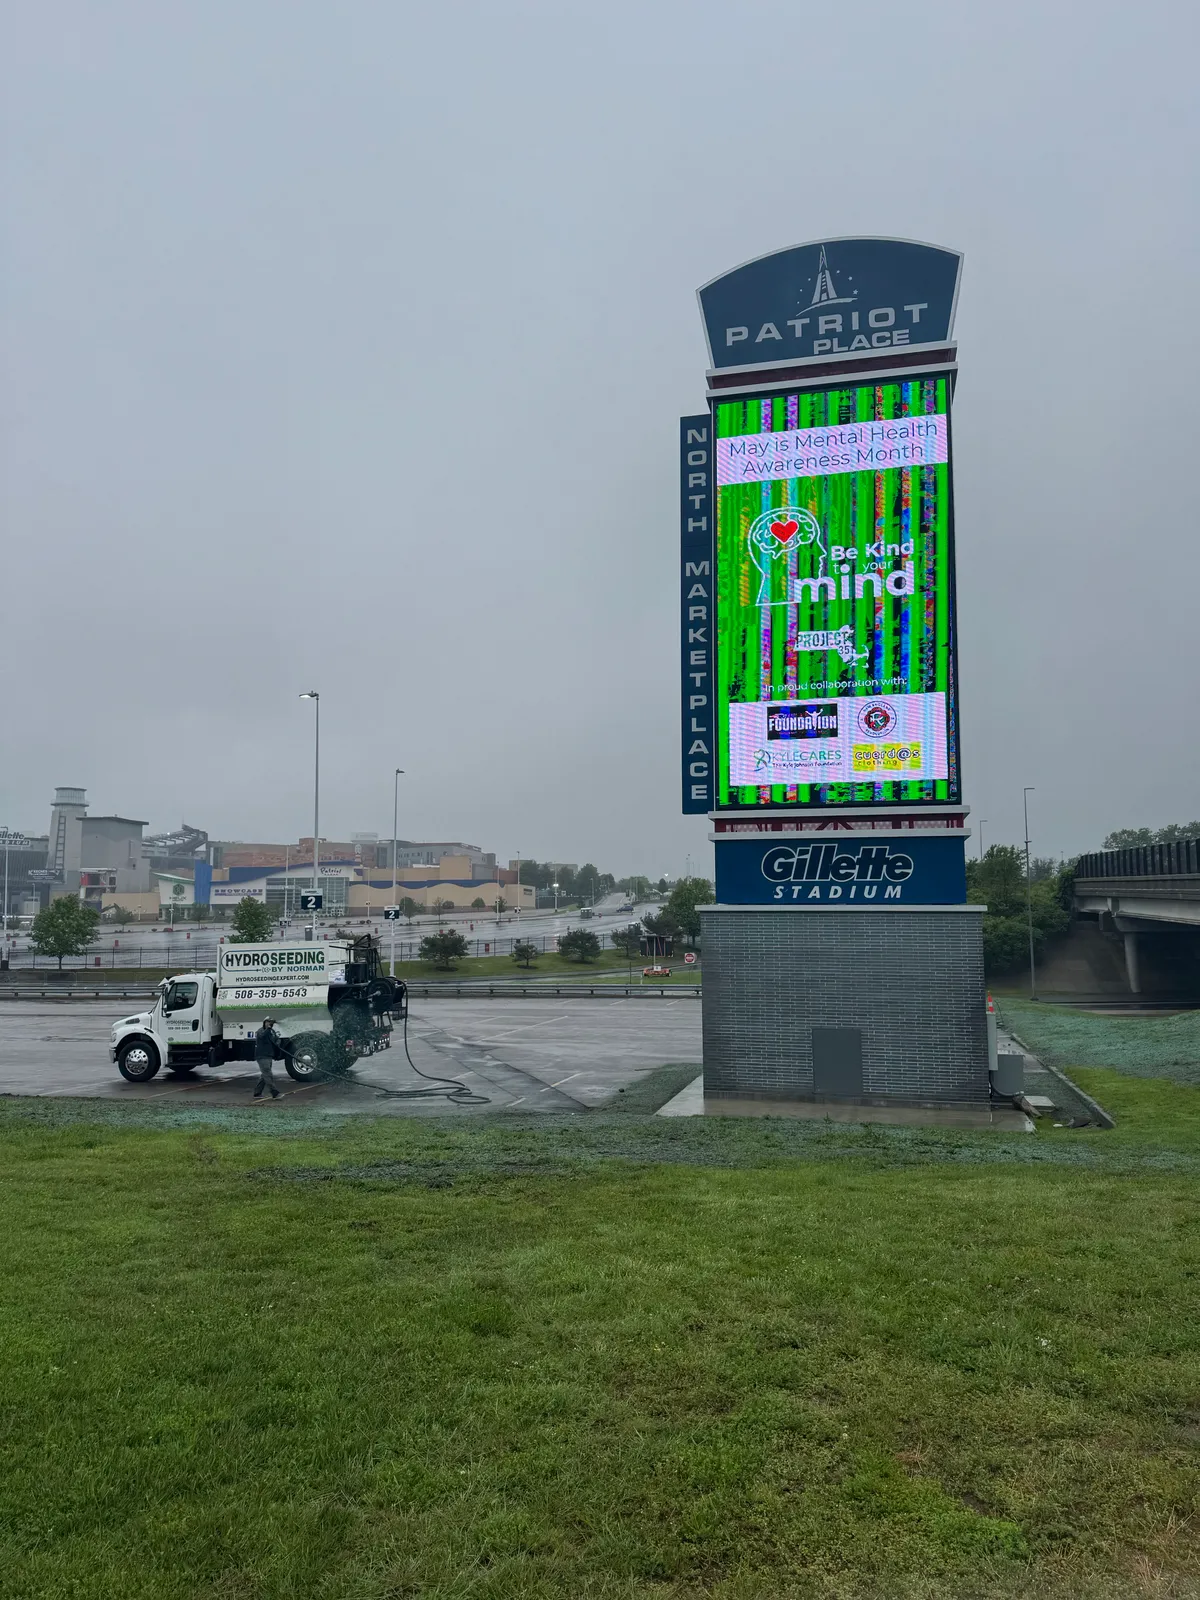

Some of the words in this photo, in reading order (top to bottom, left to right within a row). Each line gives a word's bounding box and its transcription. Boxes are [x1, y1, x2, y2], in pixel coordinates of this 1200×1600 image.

[726, 303, 928, 346] PATRIOT
[813, 329, 910, 355] PLACE
[729, 441, 769, 458] May
[775, 437, 789, 452] is
[795, 427, 863, 451] Mental
[870, 421, 938, 442] Health
[743, 453, 850, 476] Awareness
[857, 443, 923, 464] Month
[687, 428, 708, 533] NORTH
[831, 545, 858, 561] Be
[865, 538, 914, 558] Kind
[862, 559, 893, 573] your
[793, 560, 915, 603] mind
[797, 631, 849, 648] PROJECT
[685, 561, 710, 800] MARKETPLACE
[777, 682, 808, 693] proud
[810, 678, 879, 690] collaboration
[768, 712, 837, 732] FOUNDATION
[772, 750, 842, 762] KYLECARES
[855, 747, 920, 761] cuerd@s
[0, 830, 25, 840] illette
[761, 844, 914, 883] Gillette
[773, 885, 902, 899] STADIUM
[307, 896, 316, 908] 2
[388, 910, 395, 919] 2
[225, 951, 325, 967] HYDROSEEDING
[286, 965, 325, 973] NORMAN
[235, 974, 310, 983] HYDROSEEDINGEXPERT.COM
[234, 988, 308, 999] 508-359-6543
